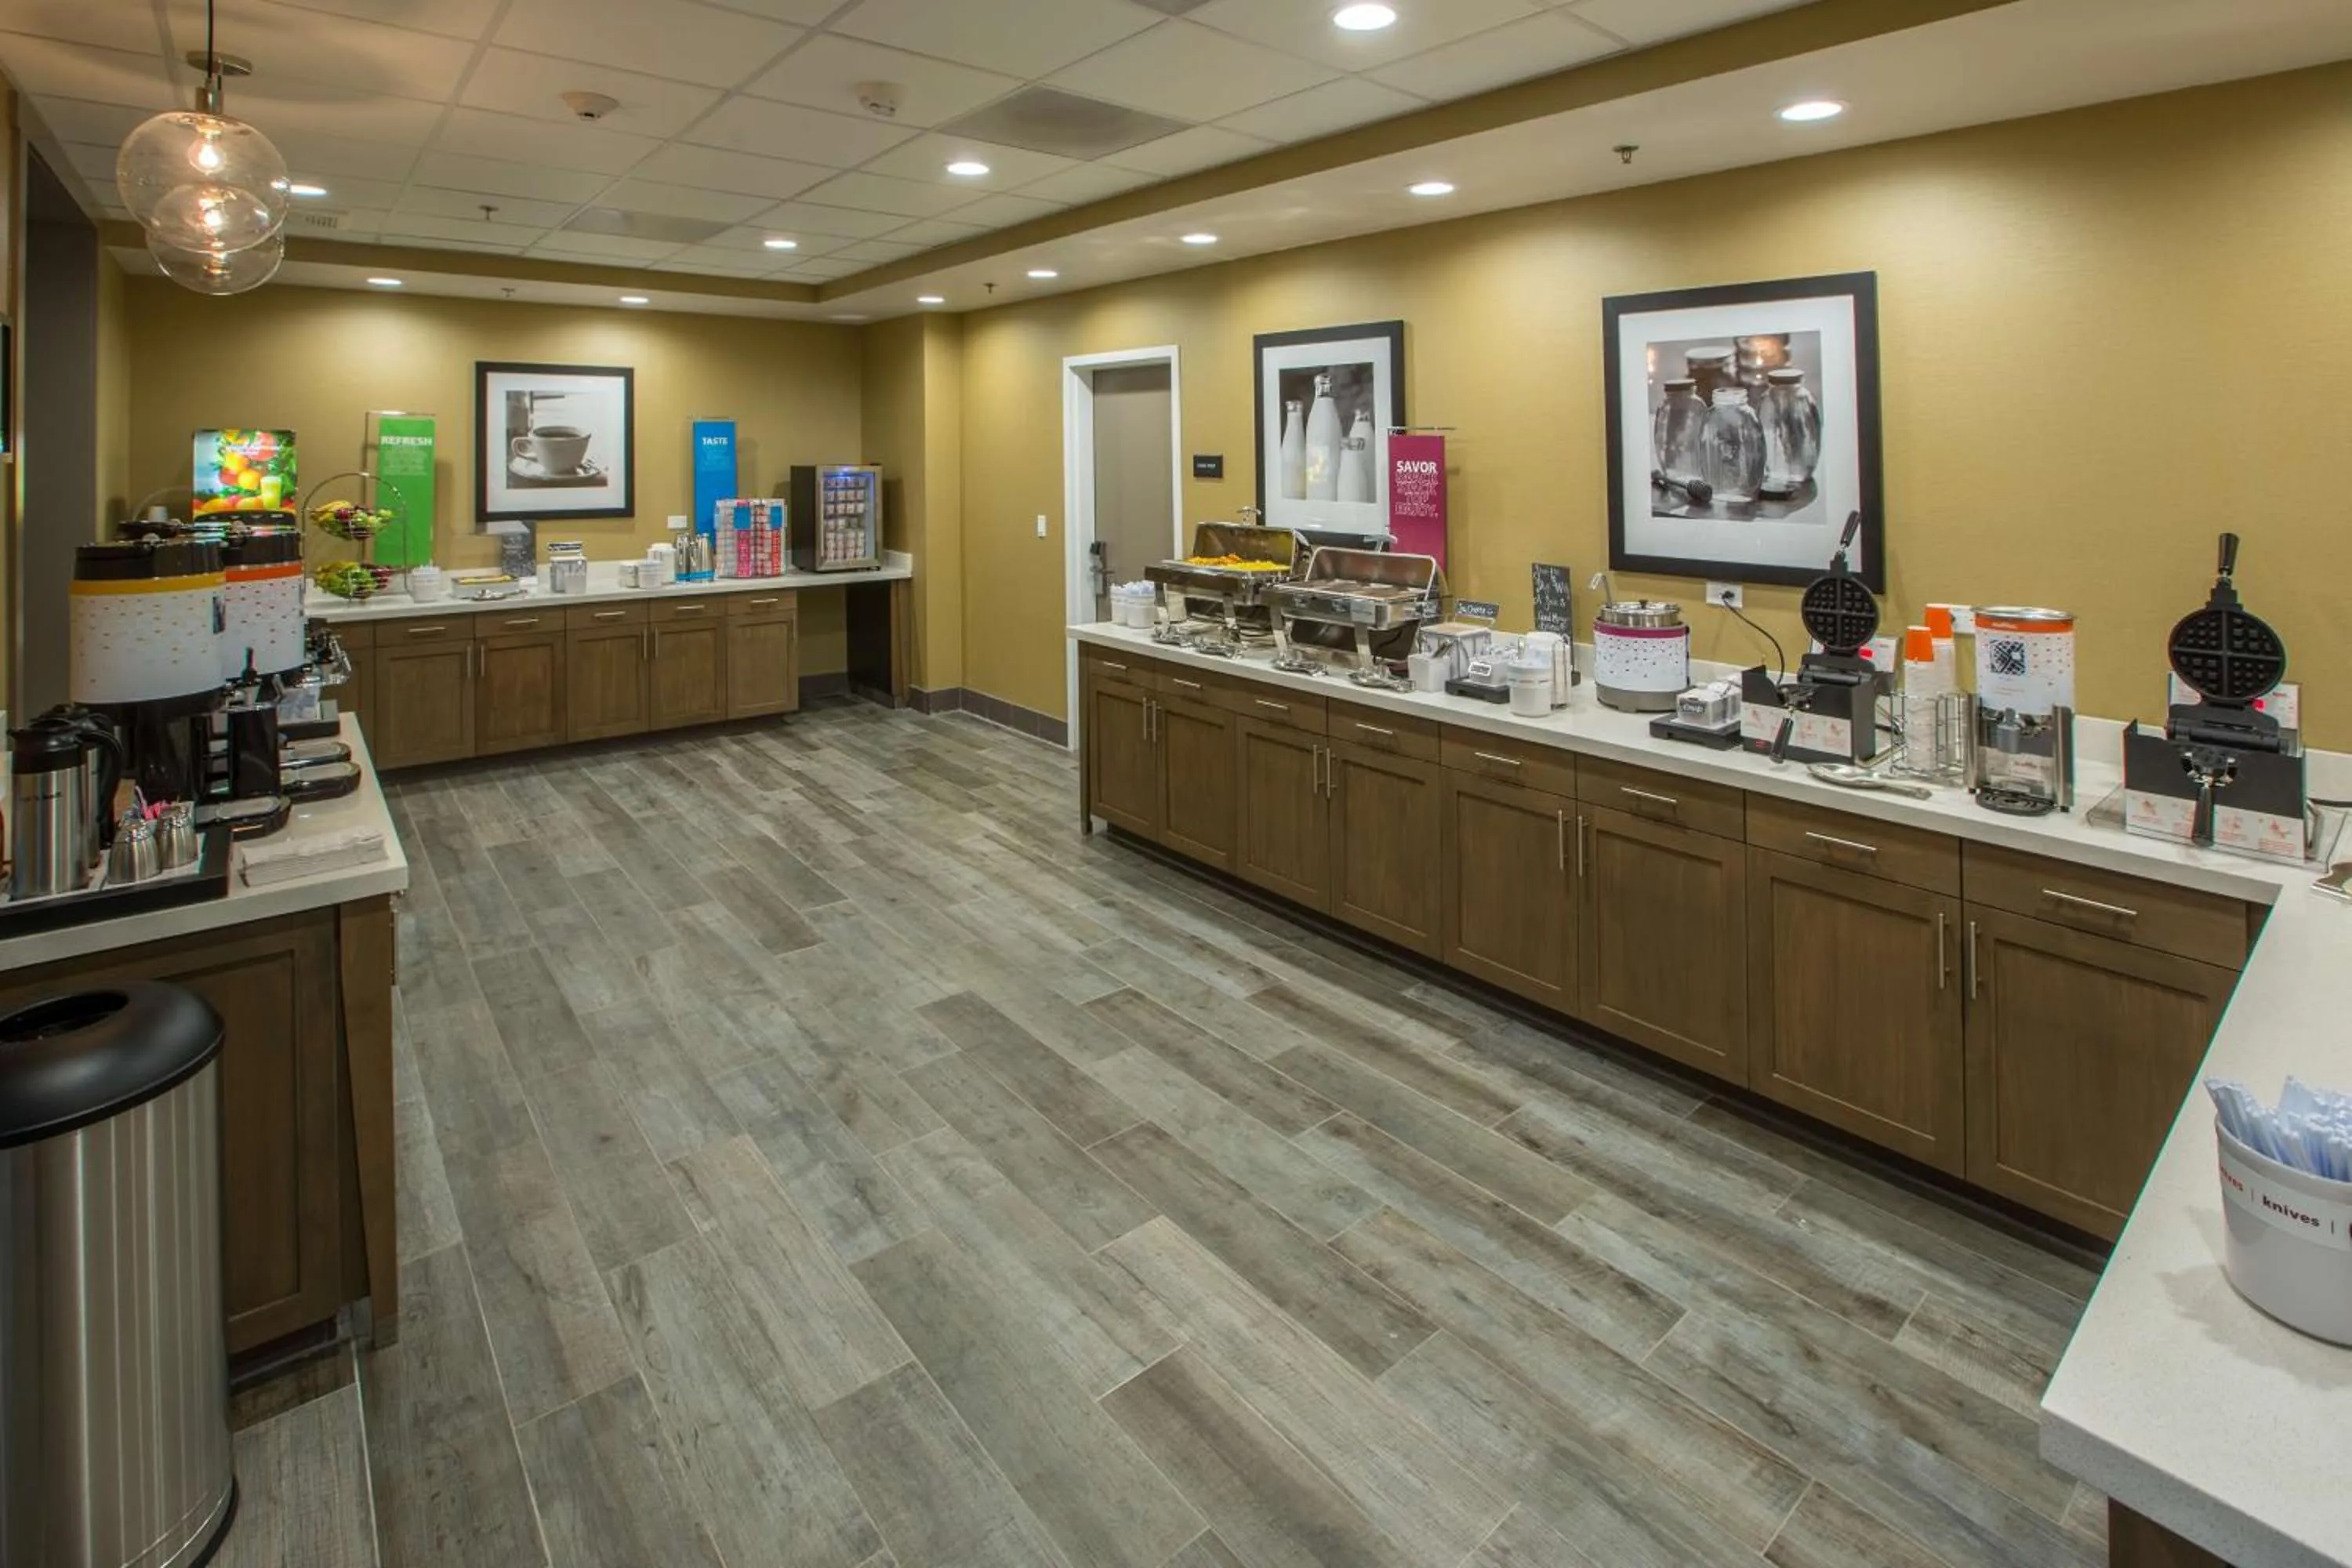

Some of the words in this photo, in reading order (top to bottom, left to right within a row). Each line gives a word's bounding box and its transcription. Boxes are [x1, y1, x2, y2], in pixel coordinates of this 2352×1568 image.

[380, 436, 433, 446] REFRESH
[702, 437, 728, 446] TASTE
[1396, 460, 1437, 474] SAVOR
[2263, 1194, 2321, 1228] knives
